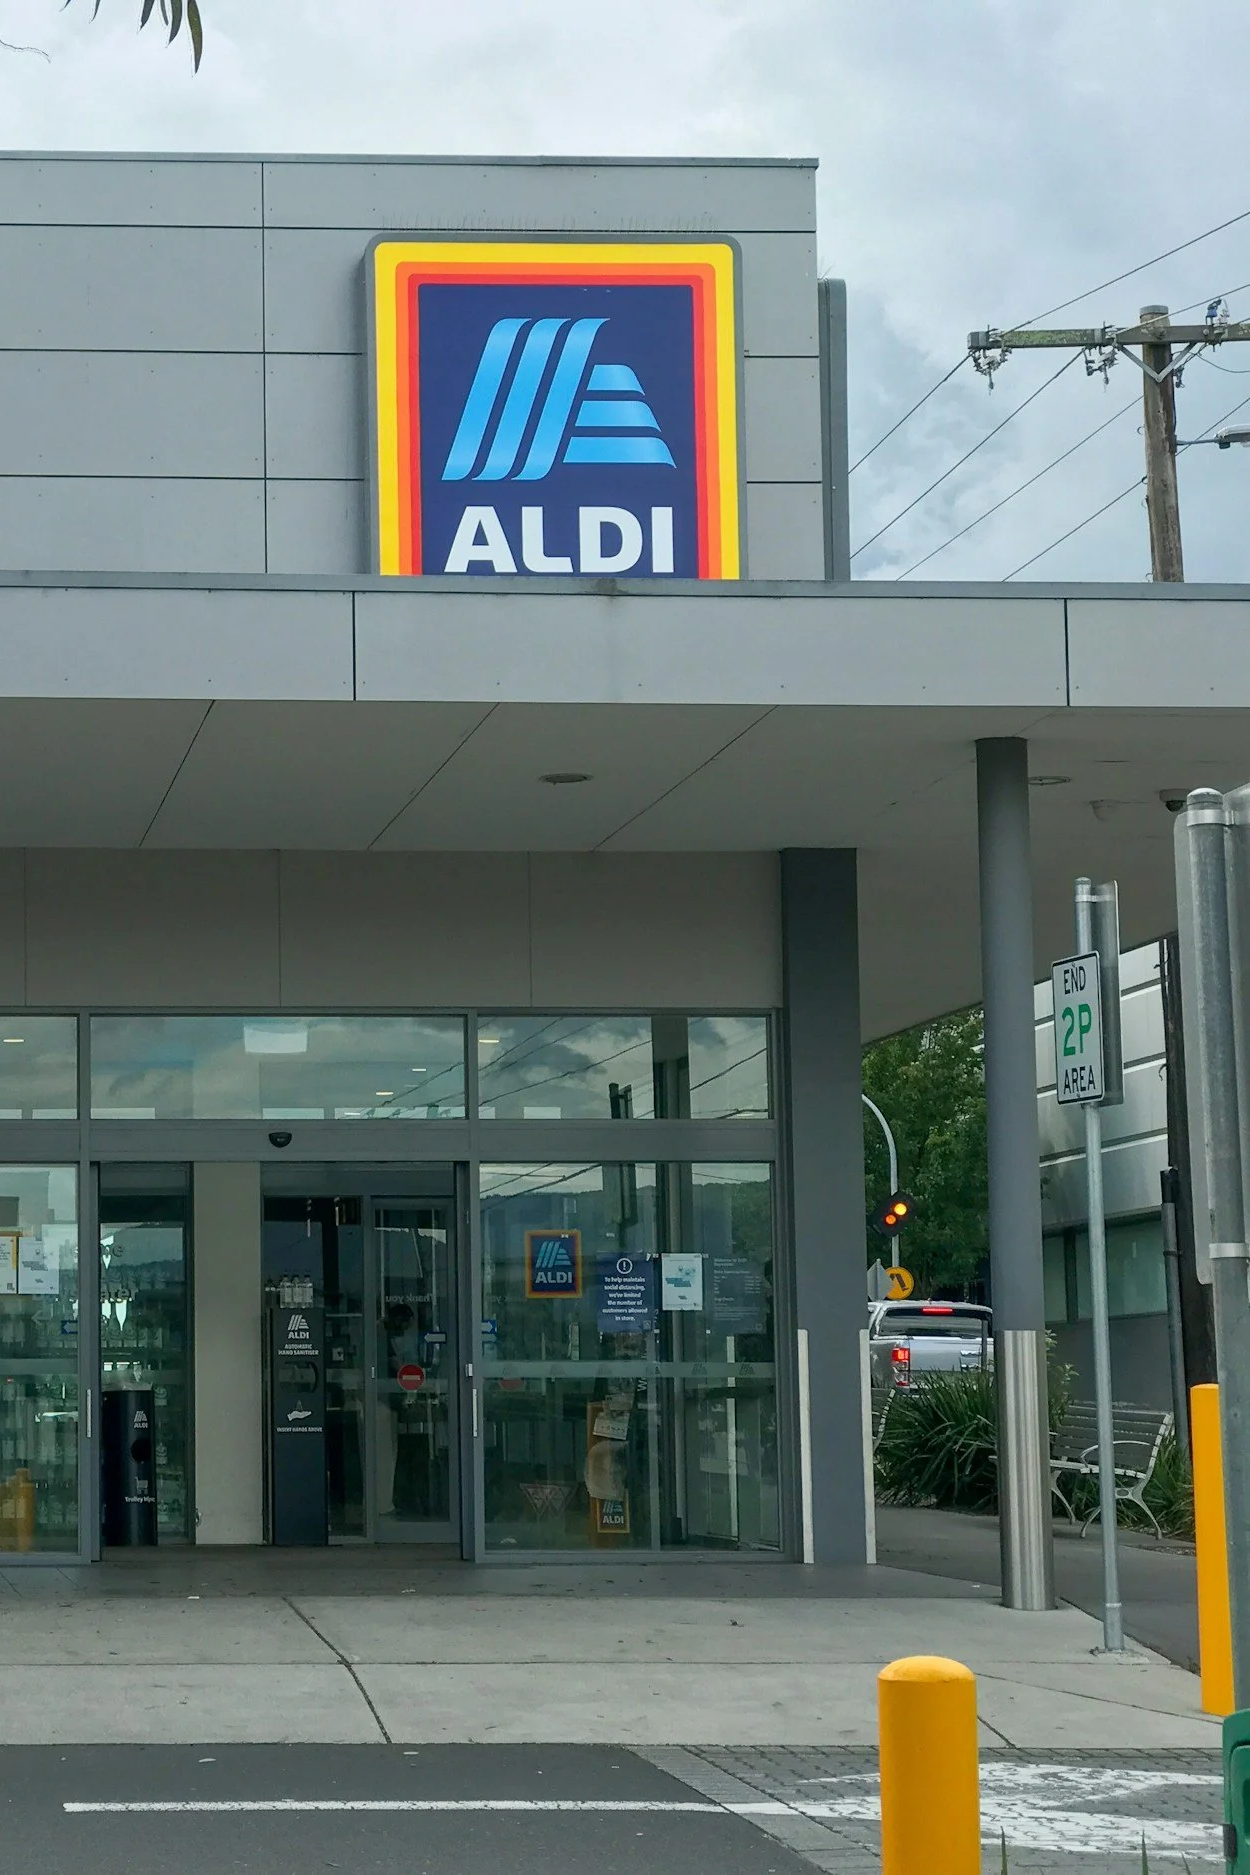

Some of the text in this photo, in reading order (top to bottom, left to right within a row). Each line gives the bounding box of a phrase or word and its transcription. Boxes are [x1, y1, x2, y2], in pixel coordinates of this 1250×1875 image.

[444, 505, 675, 573] ALDI
[1063, 966, 1086, 995] END
[1061, 1003, 1092, 1057] 2P
[1063, 1065, 1096, 1095] AREA
[535, 1272, 572, 1284] ALDI
[603, 1515, 624, 1524] ALDI
